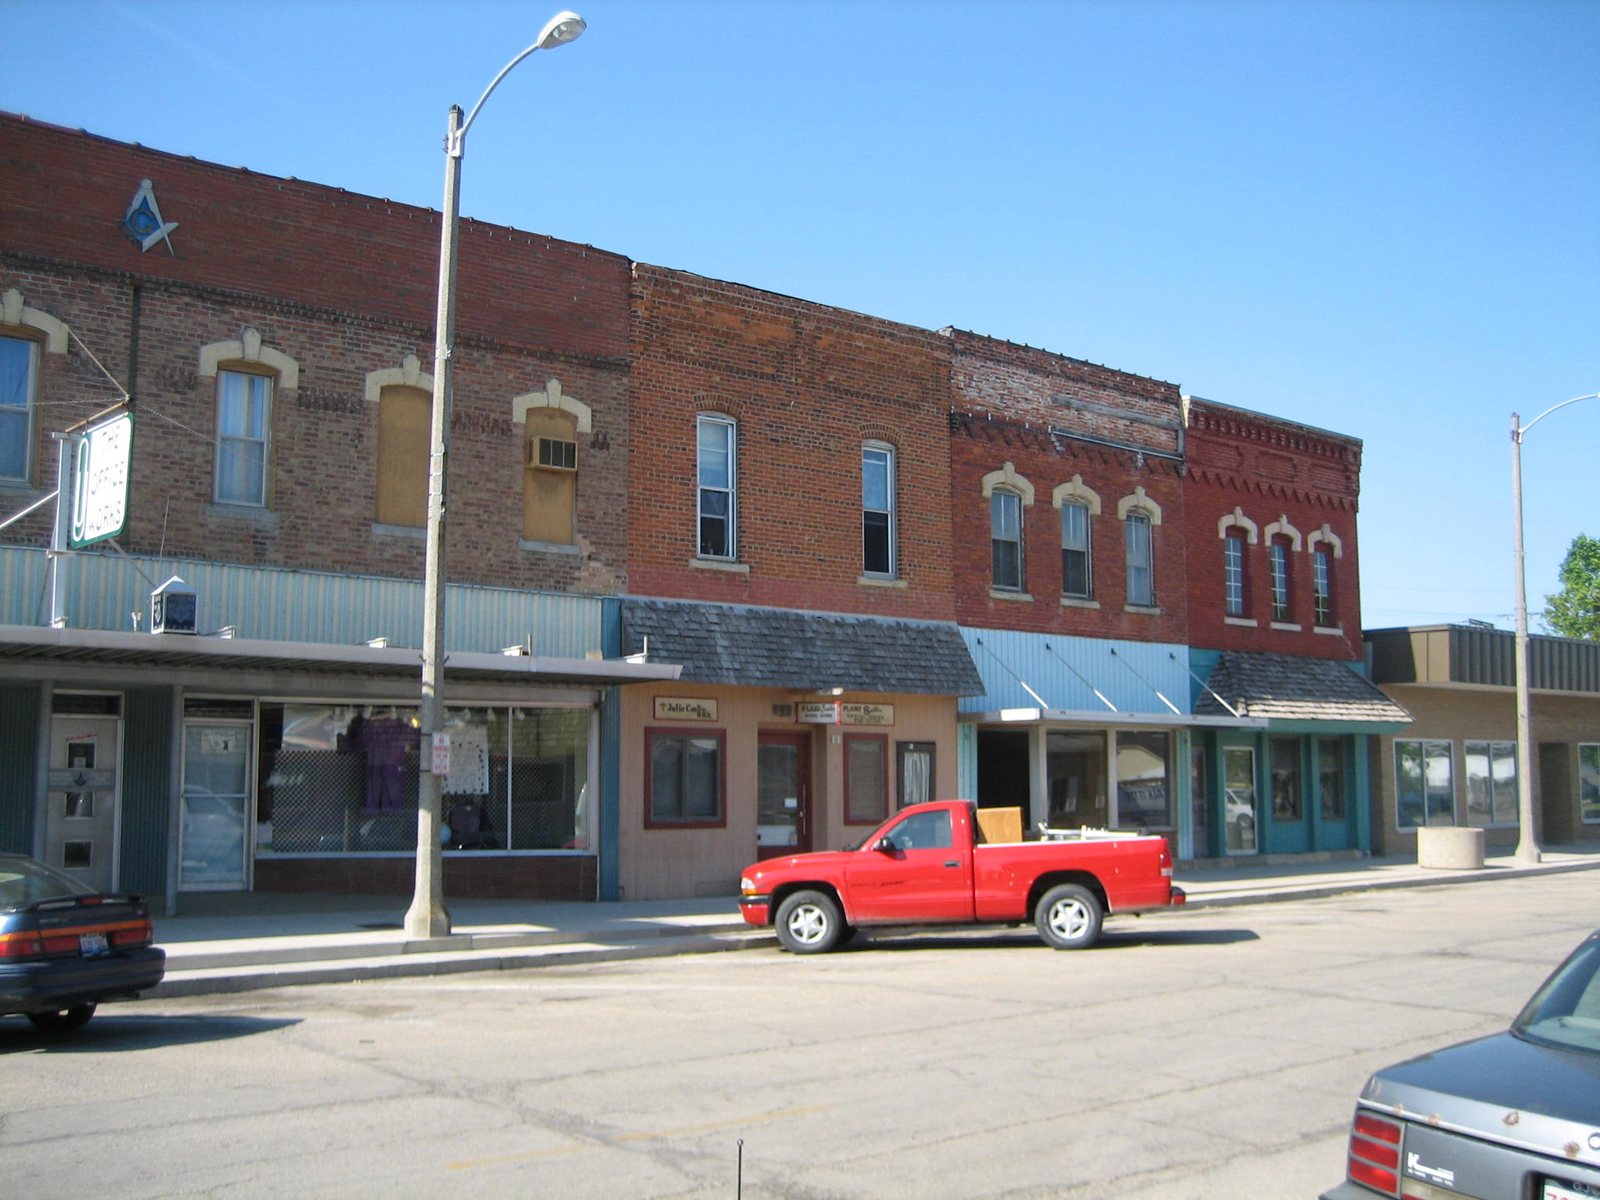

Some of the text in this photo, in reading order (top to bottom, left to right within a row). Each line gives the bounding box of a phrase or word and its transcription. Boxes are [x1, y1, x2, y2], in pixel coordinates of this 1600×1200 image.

[101, 425, 121, 455] THE
[91, 460, 126, 495] OFFICE
[88, 500, 121, 532] WORKS
